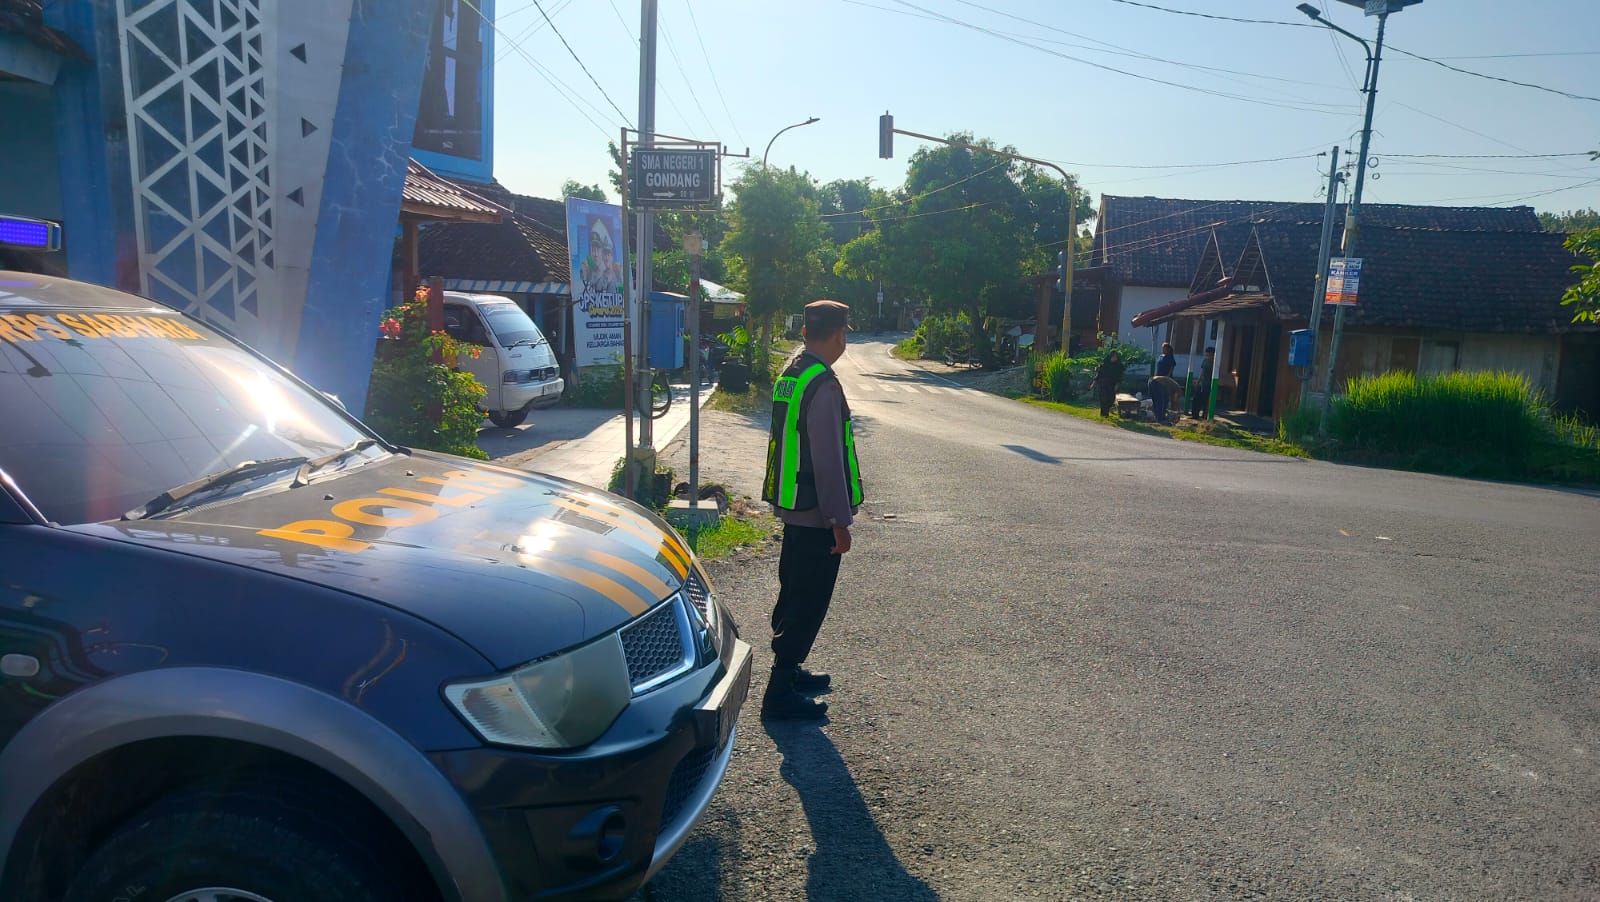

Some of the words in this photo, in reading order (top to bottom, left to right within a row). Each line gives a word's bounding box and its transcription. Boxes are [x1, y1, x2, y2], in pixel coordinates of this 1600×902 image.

[641, 155, 661, 169] SMA
[663, 156, 696, 169] NEGERI
[699, 156, 705, 170] 1
[646, 172, 700, 187] GONDANG
[596, 291, 624, 309] KETUP
